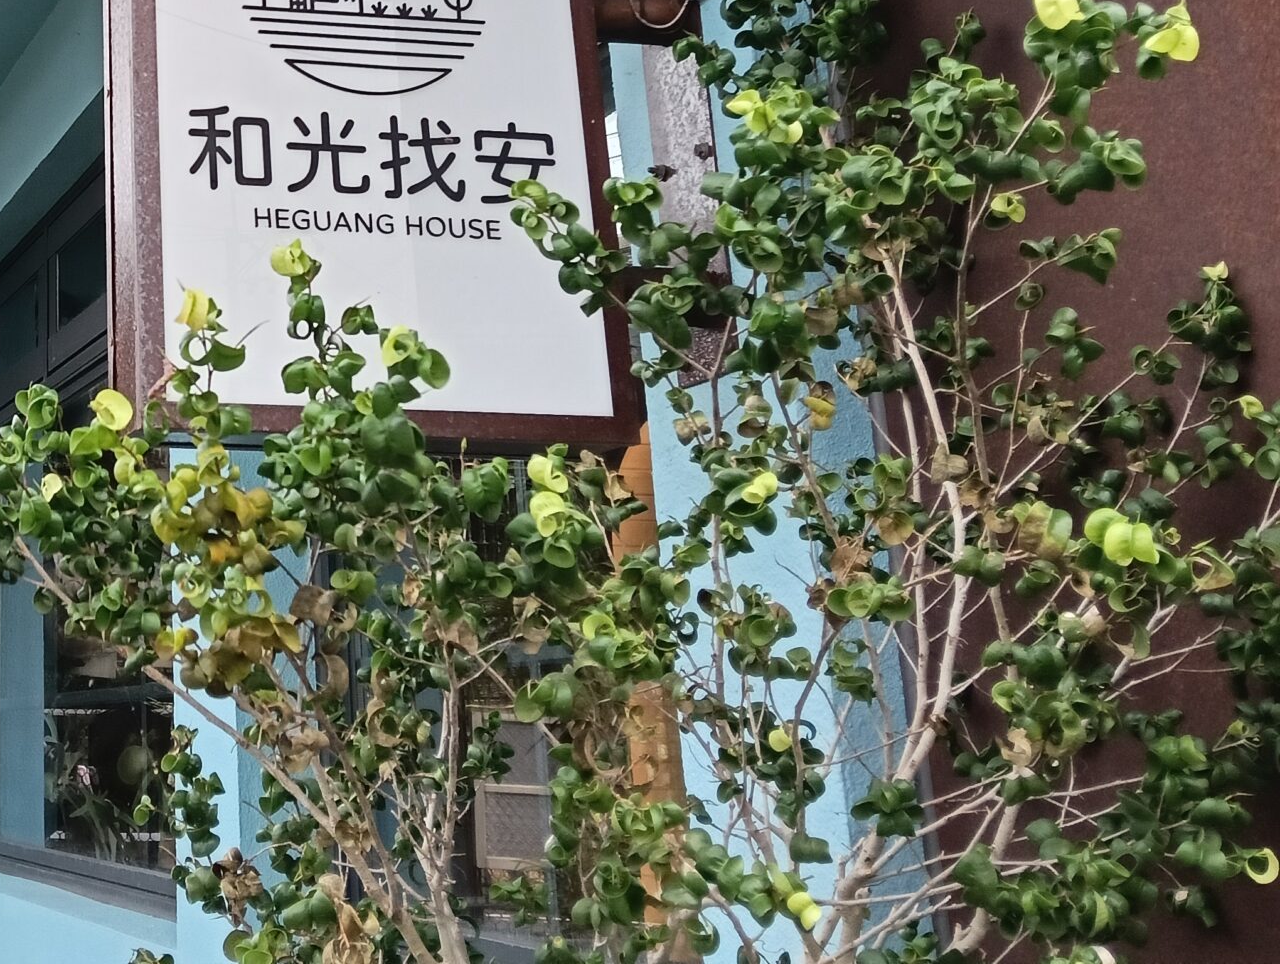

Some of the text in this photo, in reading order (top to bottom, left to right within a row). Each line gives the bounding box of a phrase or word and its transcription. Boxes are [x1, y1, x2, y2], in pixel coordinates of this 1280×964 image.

[188, 105, 556, 204] 和光找安
[254, 207, 502, 241] HEGUANG HOUSE
